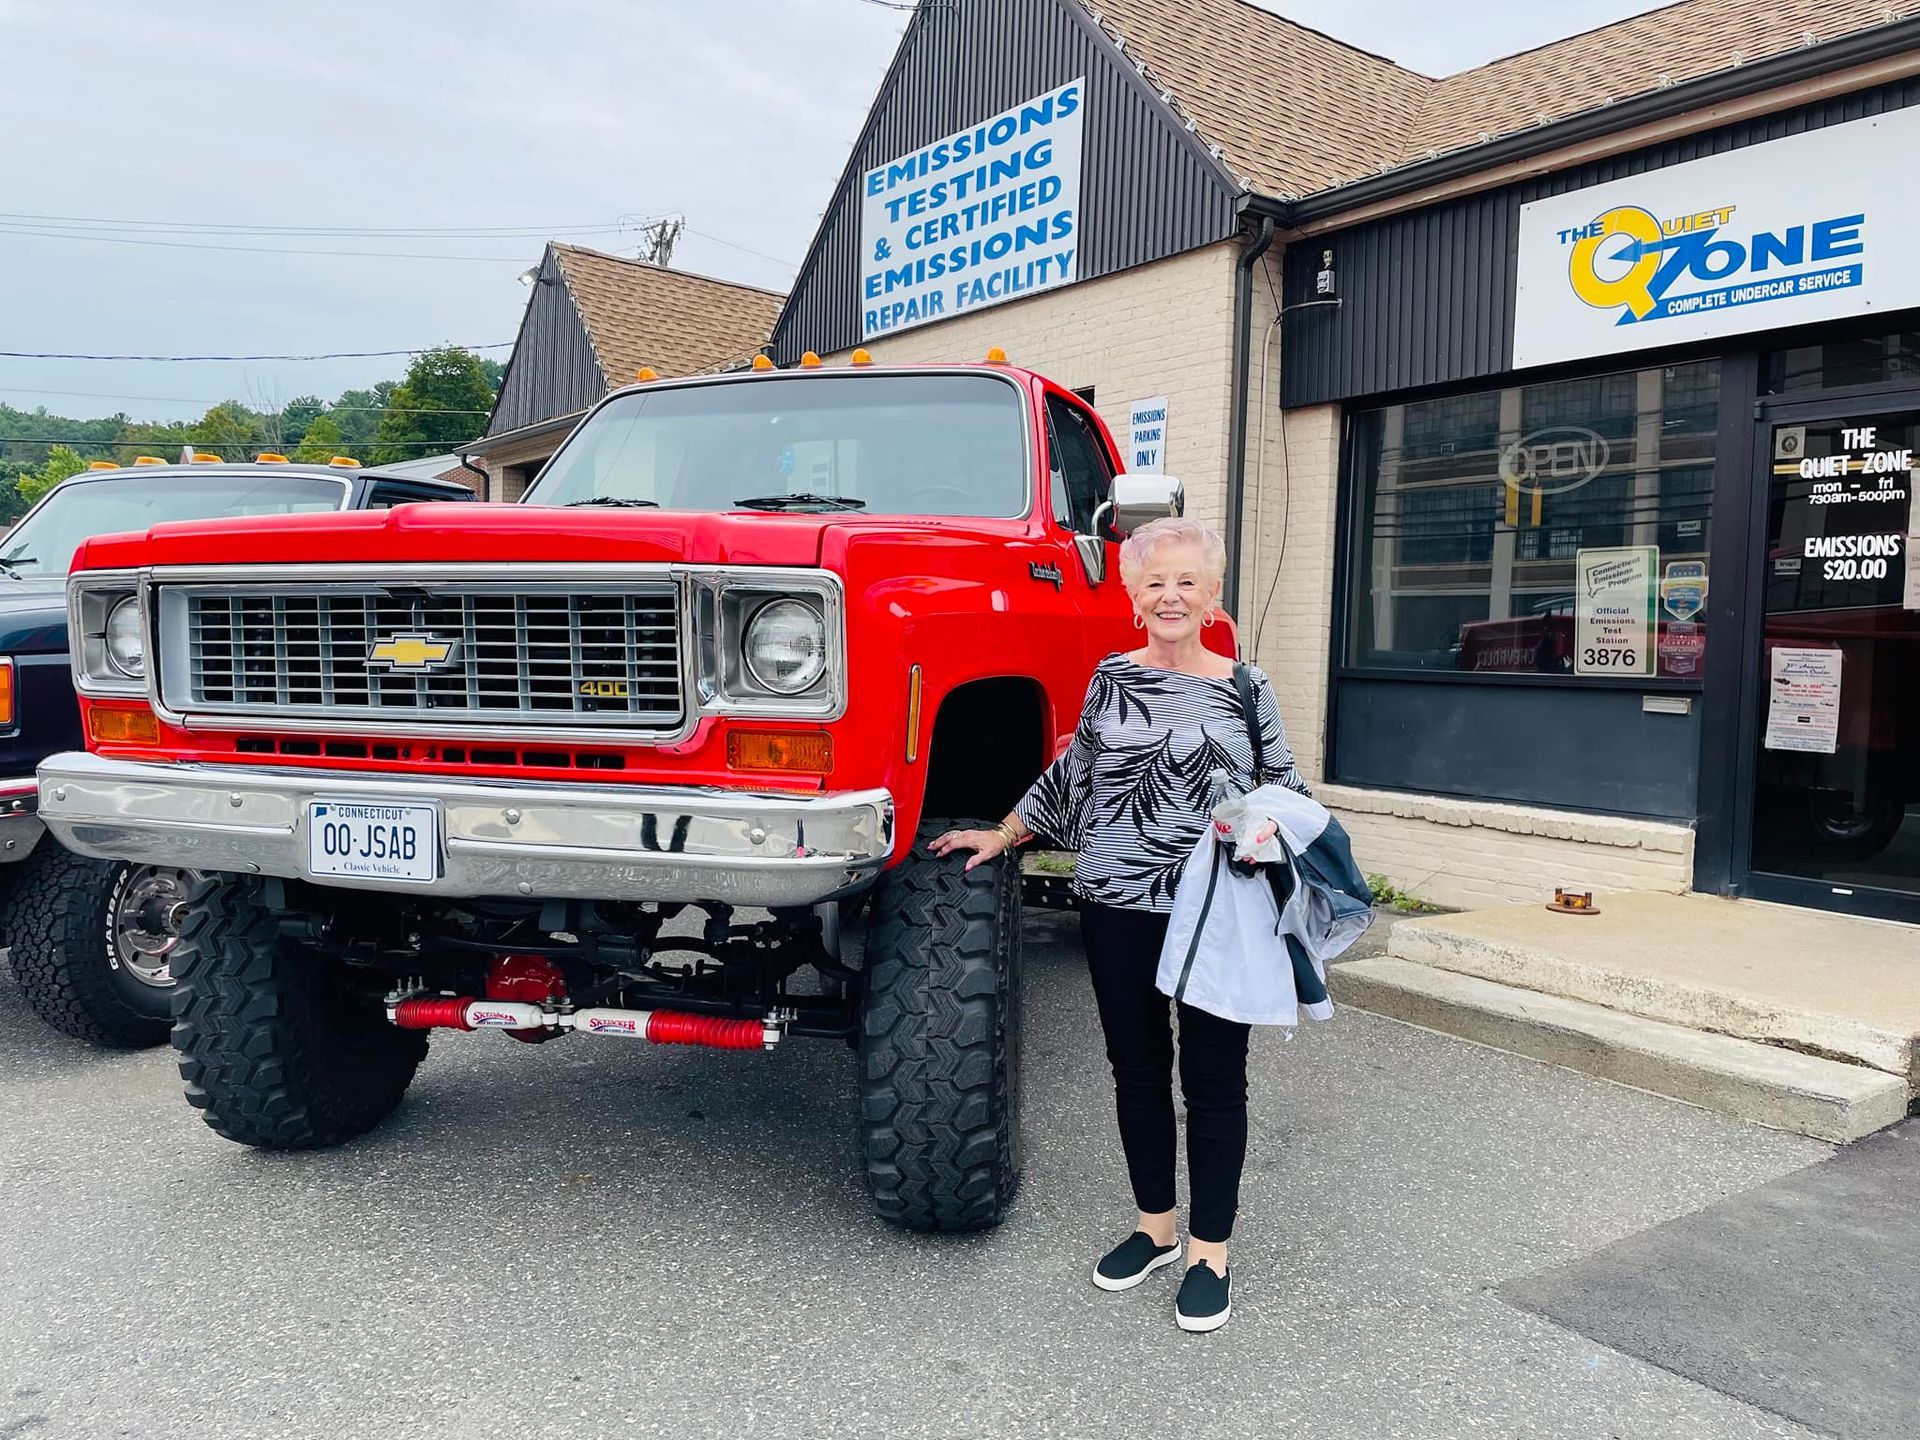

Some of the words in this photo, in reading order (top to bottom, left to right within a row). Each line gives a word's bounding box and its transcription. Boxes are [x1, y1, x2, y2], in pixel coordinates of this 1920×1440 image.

[867, 87, 1079, 197] EMISSIONS
[885, 138, 1053, 224] TESTING
[874, 236, 892, 262] &
[905, 175, 1062, 250] CERTIFIED
[1557, 221, 1605, 246] THE
[865, 210, 1073, 300] EMISSIONS
[1648, 213, 1865, 301] ZONE
[866, 290, 944, 334] REPAIR
[956, 249, 1075, 309] FACILITY
[1667, 292, 1727, 314] COMPLETE
[1731, 282, 1794, 303] UNDERCAR
[1798, 269, 1851, 292] SERVICE
[1132, 408, 1166, 425] EMISSIONS
[1134, 428, 1161, 444] PARKING
[1841, 427, 1877, 450] THE
[1136, 449, 1157, 467] ONLY
[1508, 440, 1597, 479] OPEN
[1800, 455, 1851, 479] QUIET
[1862, 450, 1913, 475] ZONE
[1813, 482, 1842, 494] mon
[1878, 477, 1894, 490] fri
[1804, 535, 1901, 558] EMISSIONS
[1592, 557, 1641, 577] Connecticut
[1593, 568, 1633, 585] Emissions
[1823, 559, 1887, 580] $20.00
[1608, 573, 1643, 588] Program
[1590, 617, 1635, 625] Emissions
[1596, 607, 1629, 615] Official
[1596, 637, 1629, 645] Station
[1583, 648, 1636, 667] 3876
[338, 807, 403, 820] CONNECTICUT
[343, 862, 371, 873] Classic
[372, 863, 401, 874] Vehicle
